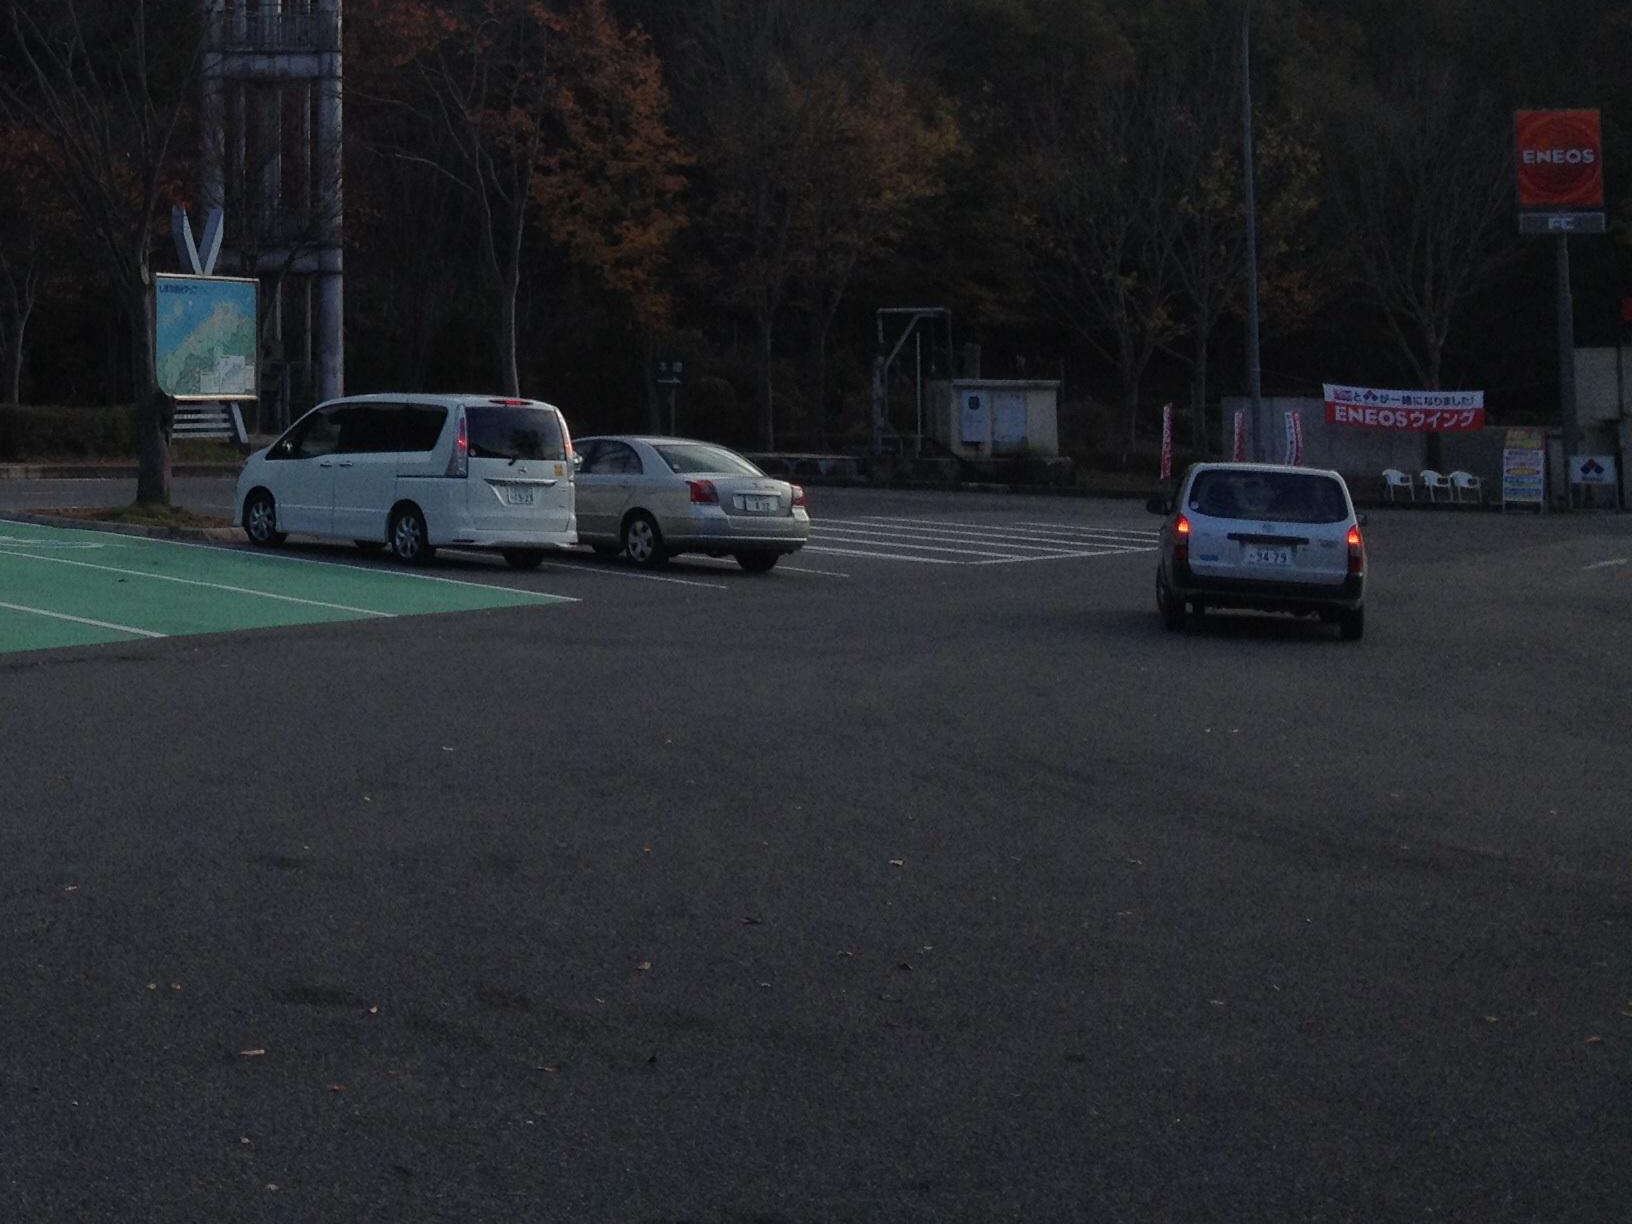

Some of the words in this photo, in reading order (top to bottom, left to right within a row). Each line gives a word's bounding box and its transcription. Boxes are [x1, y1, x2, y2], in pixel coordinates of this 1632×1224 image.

[1522, 149, 1594, 164] ENEOS
[1335, 406, 1475, 428] ENEOSウイング
